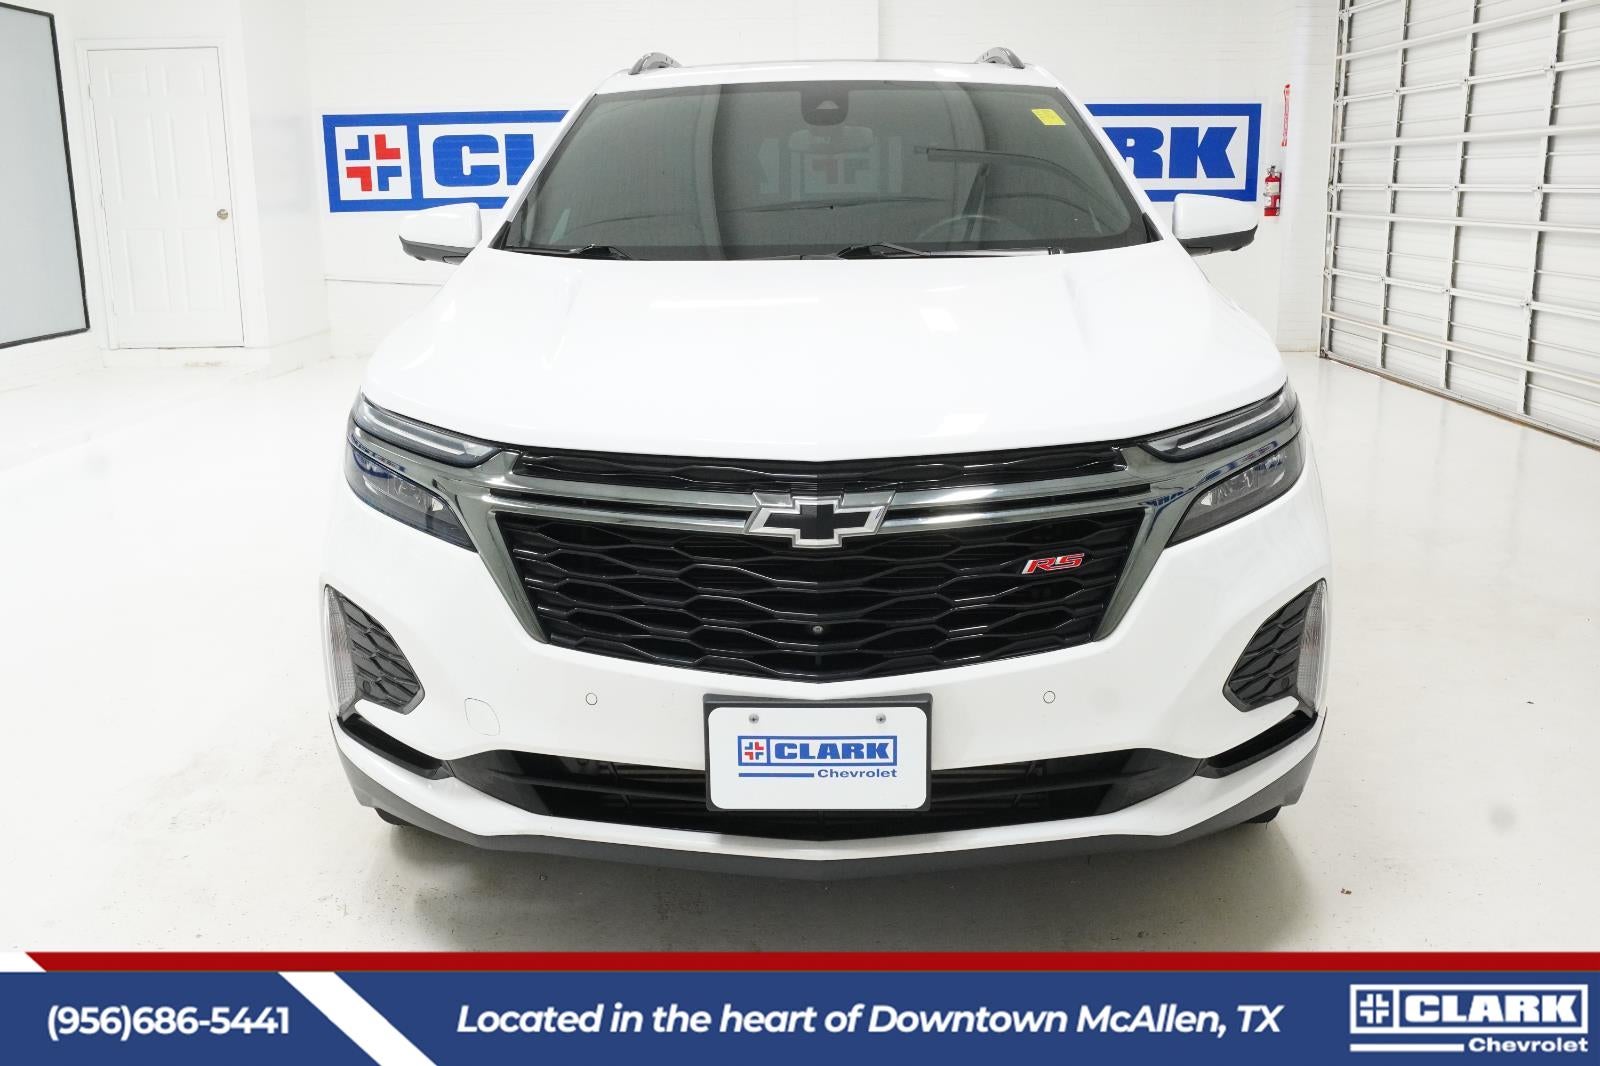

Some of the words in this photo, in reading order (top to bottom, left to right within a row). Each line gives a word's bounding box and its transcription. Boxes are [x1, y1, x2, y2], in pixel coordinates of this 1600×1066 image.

[1021, 552, 1085, 575] RS
[774, 742, 890, 760] CLARK
[817, 768, 898, 779] Chevrolet
